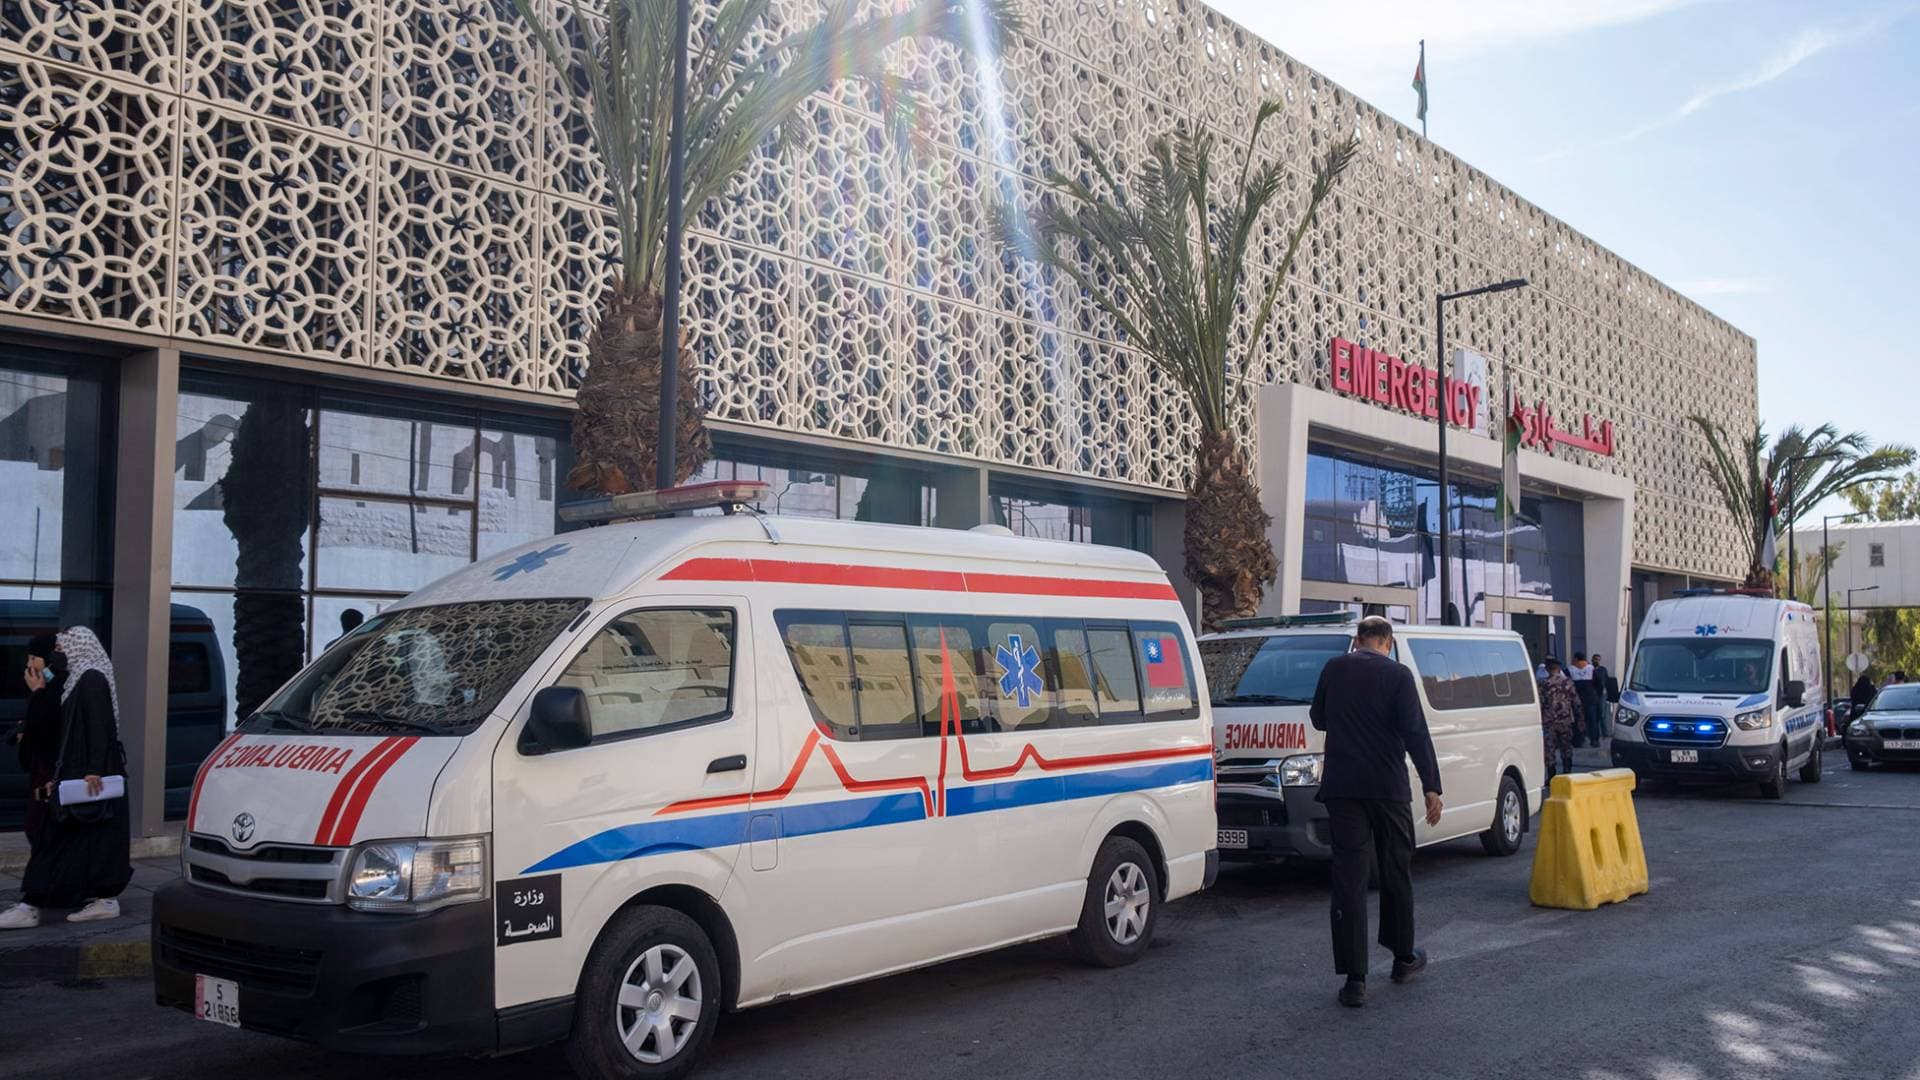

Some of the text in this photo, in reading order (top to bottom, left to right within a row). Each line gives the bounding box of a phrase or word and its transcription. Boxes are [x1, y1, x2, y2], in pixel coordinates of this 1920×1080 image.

[1331, 337, 1480, 429] EMERGENCY
[513, 889, 545, 907] وزارة
[504, 914, 554, 937] الصحة
[216, 983, 223, 1000] 5
